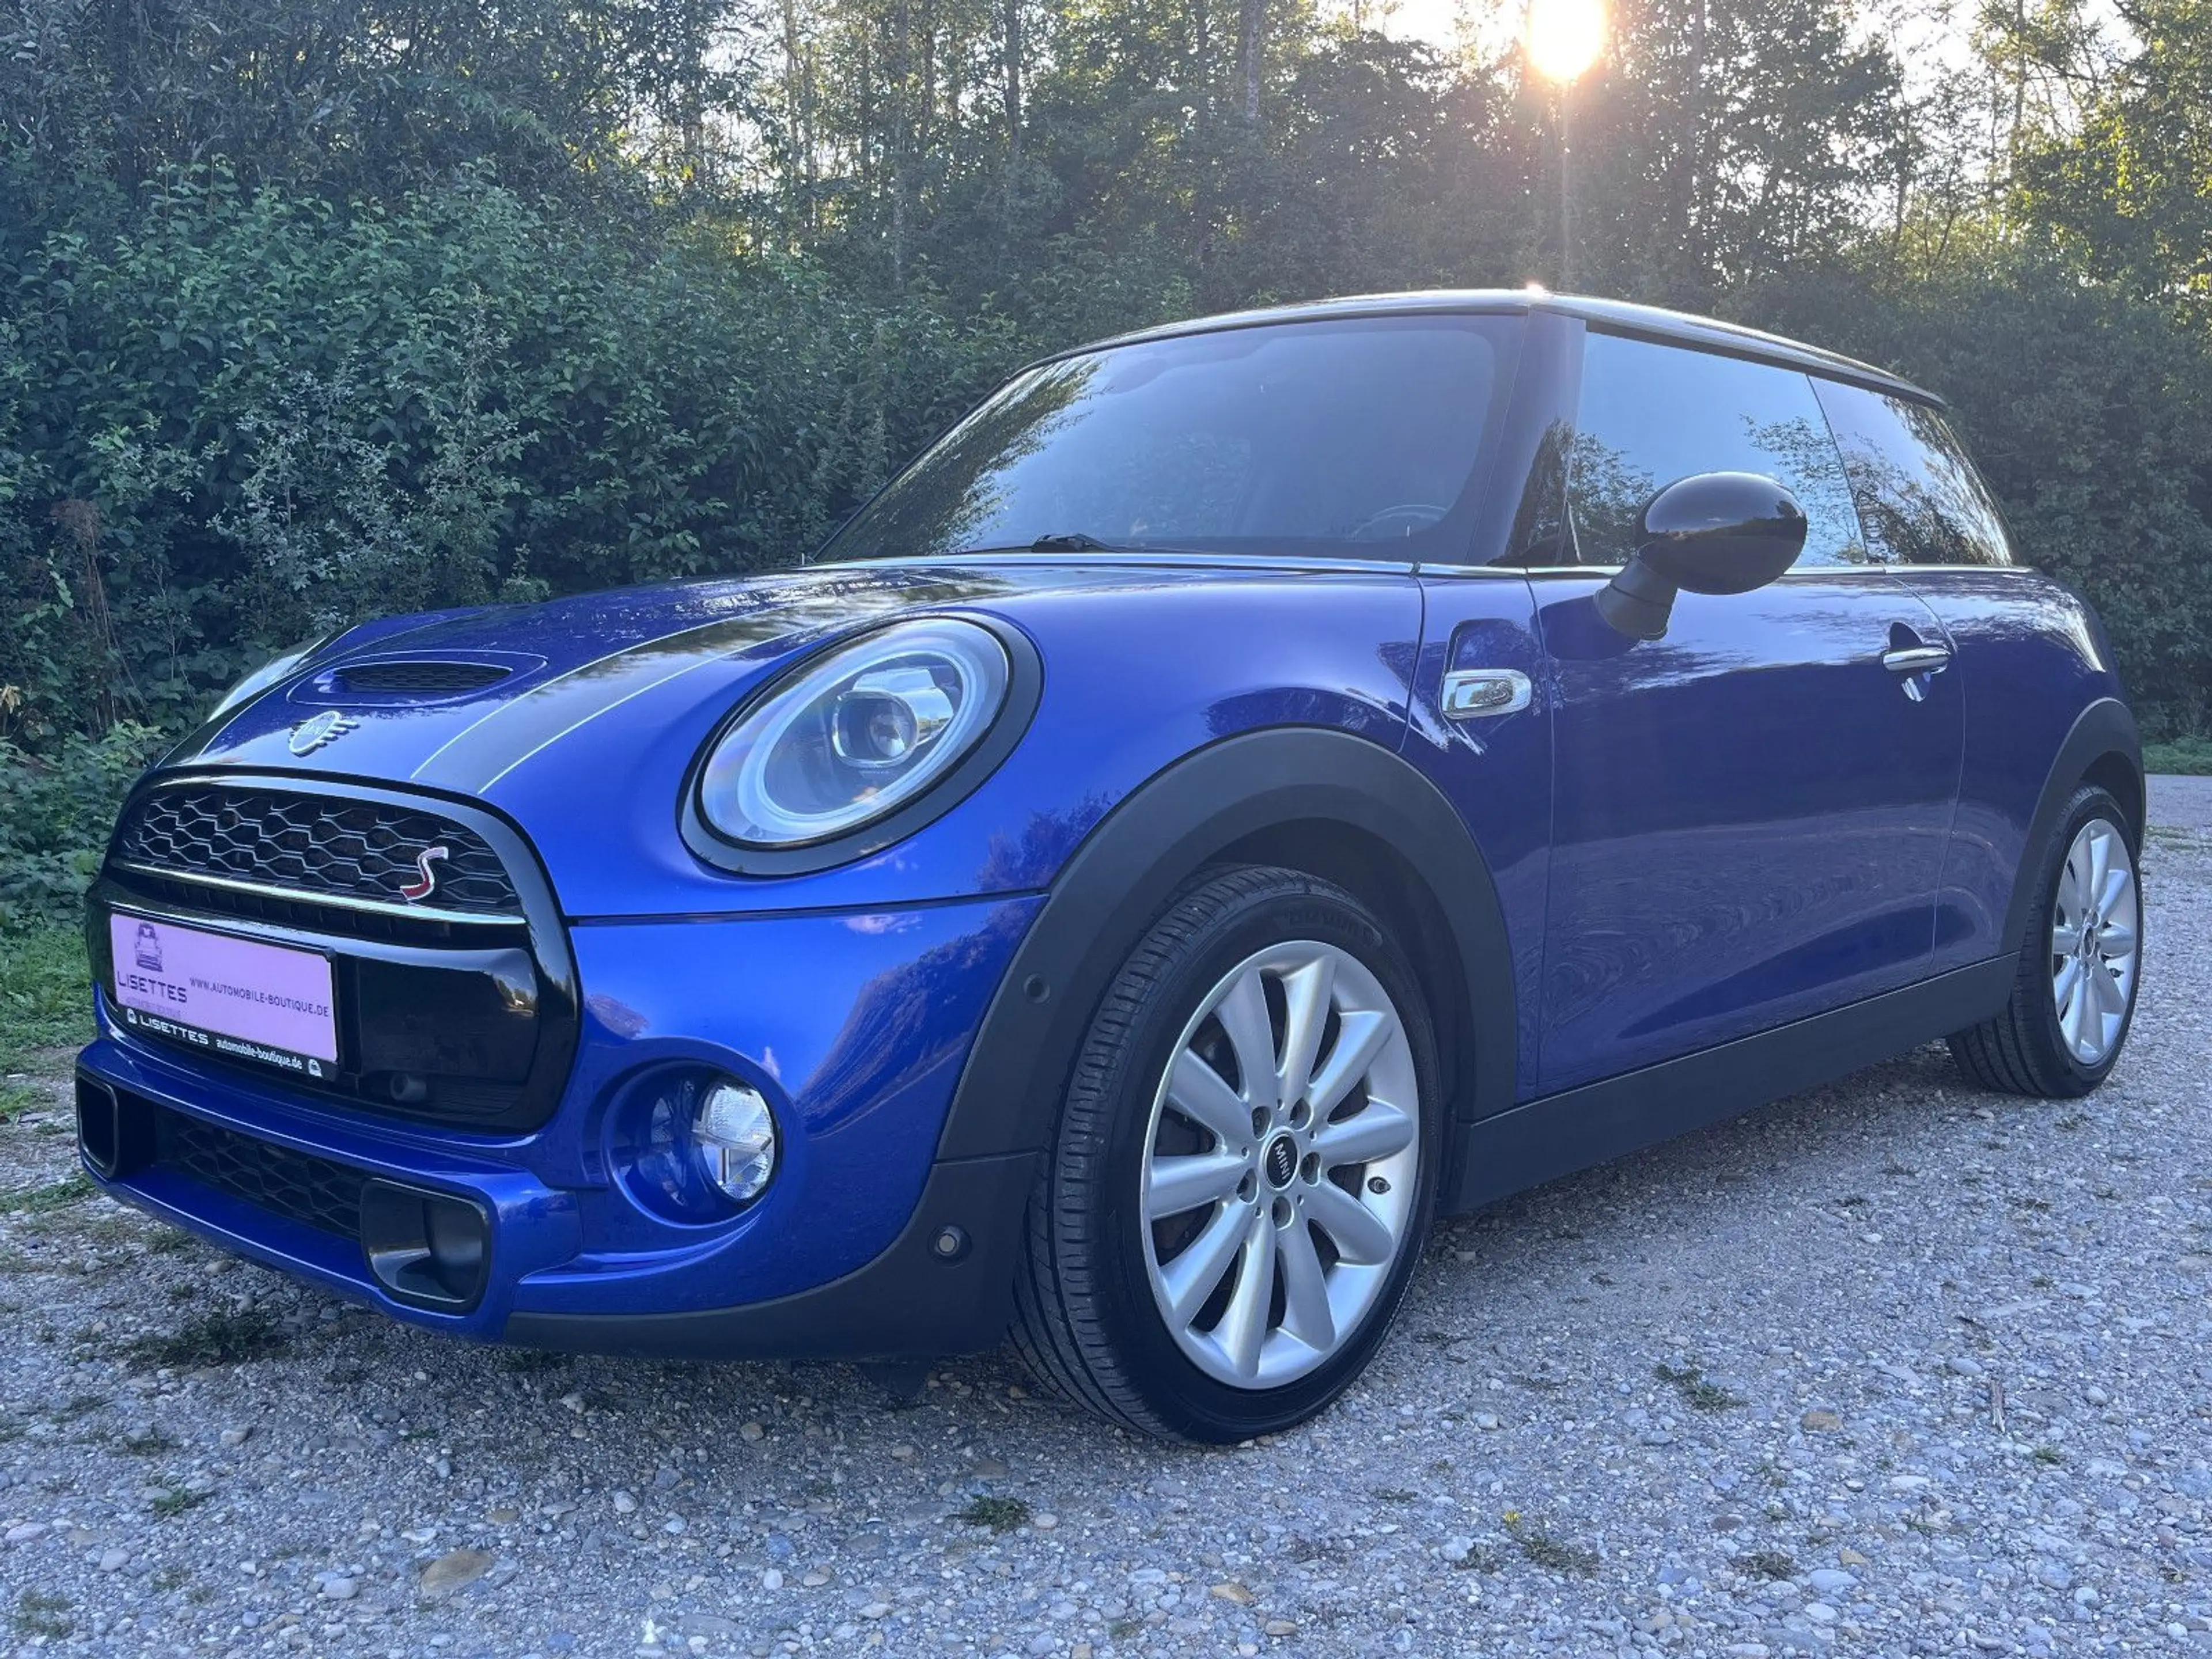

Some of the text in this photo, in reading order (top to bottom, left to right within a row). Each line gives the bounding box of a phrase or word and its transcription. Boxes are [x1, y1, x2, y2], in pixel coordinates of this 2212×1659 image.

[399, 846, 449, 901] S
[117, 971, 187, 1003] LISETTES
[190, 977, 328, 1017] WWW.AUTOMOBILE-BOUTIQUE.DE
[139, 1014, 209, 1044] LISETTES
[216, 1039, 302, 1070] automobile-boutique.de
[1274, 1142, 1291, 1180] MINI
